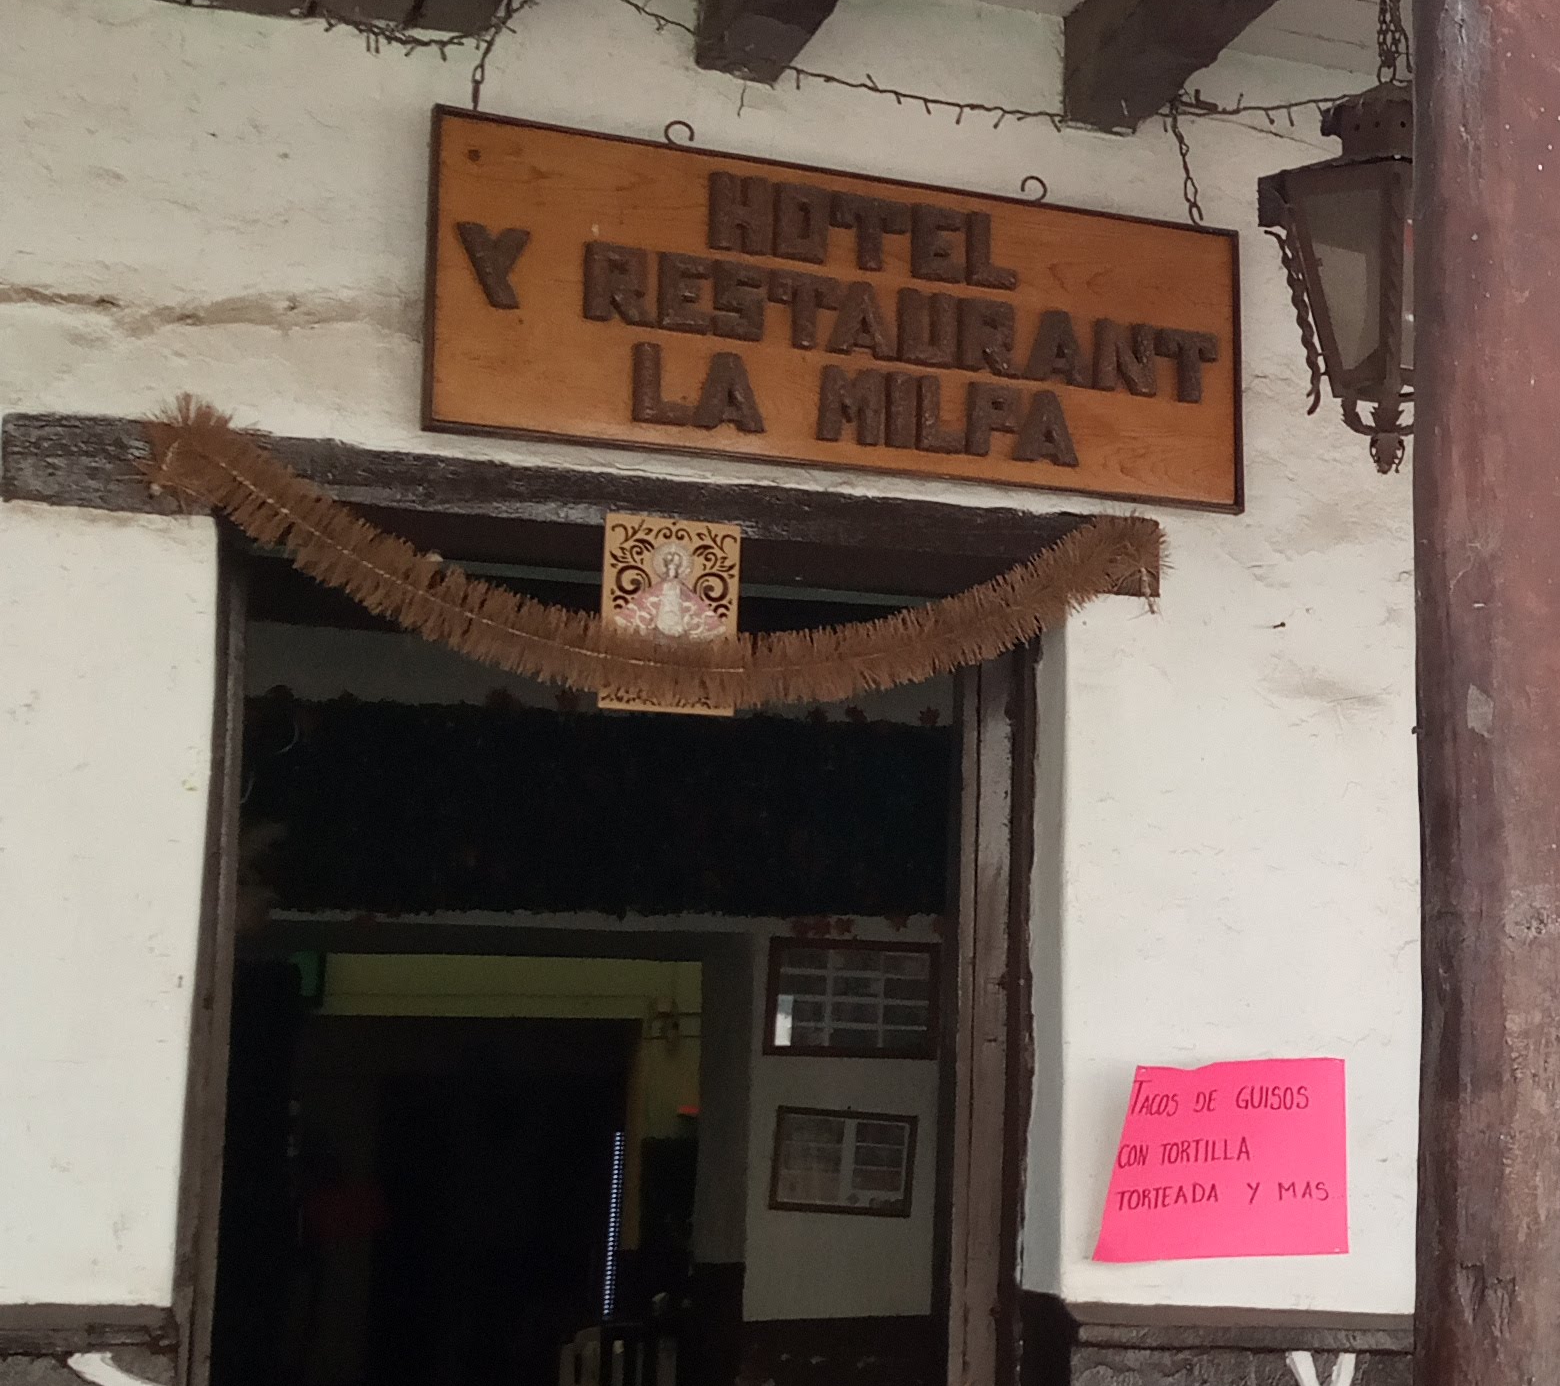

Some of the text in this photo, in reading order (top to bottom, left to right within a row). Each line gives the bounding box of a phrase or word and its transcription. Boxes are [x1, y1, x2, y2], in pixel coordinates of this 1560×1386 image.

[706, 170, 1019, 291] HOTEL
[454, 221, 1219, 405] Y RESTAURANT
[631, 341, 1079, 468] LA MILPA
[1130, 1079, 1310, 1117] TACOS DE GUISOS
[1117, 1136, 1252, 1169] CON TORTILLA
[1116, 1181, 1220, 1212] TORTEADA
[1246, 1181, 1261, 1205] Y
